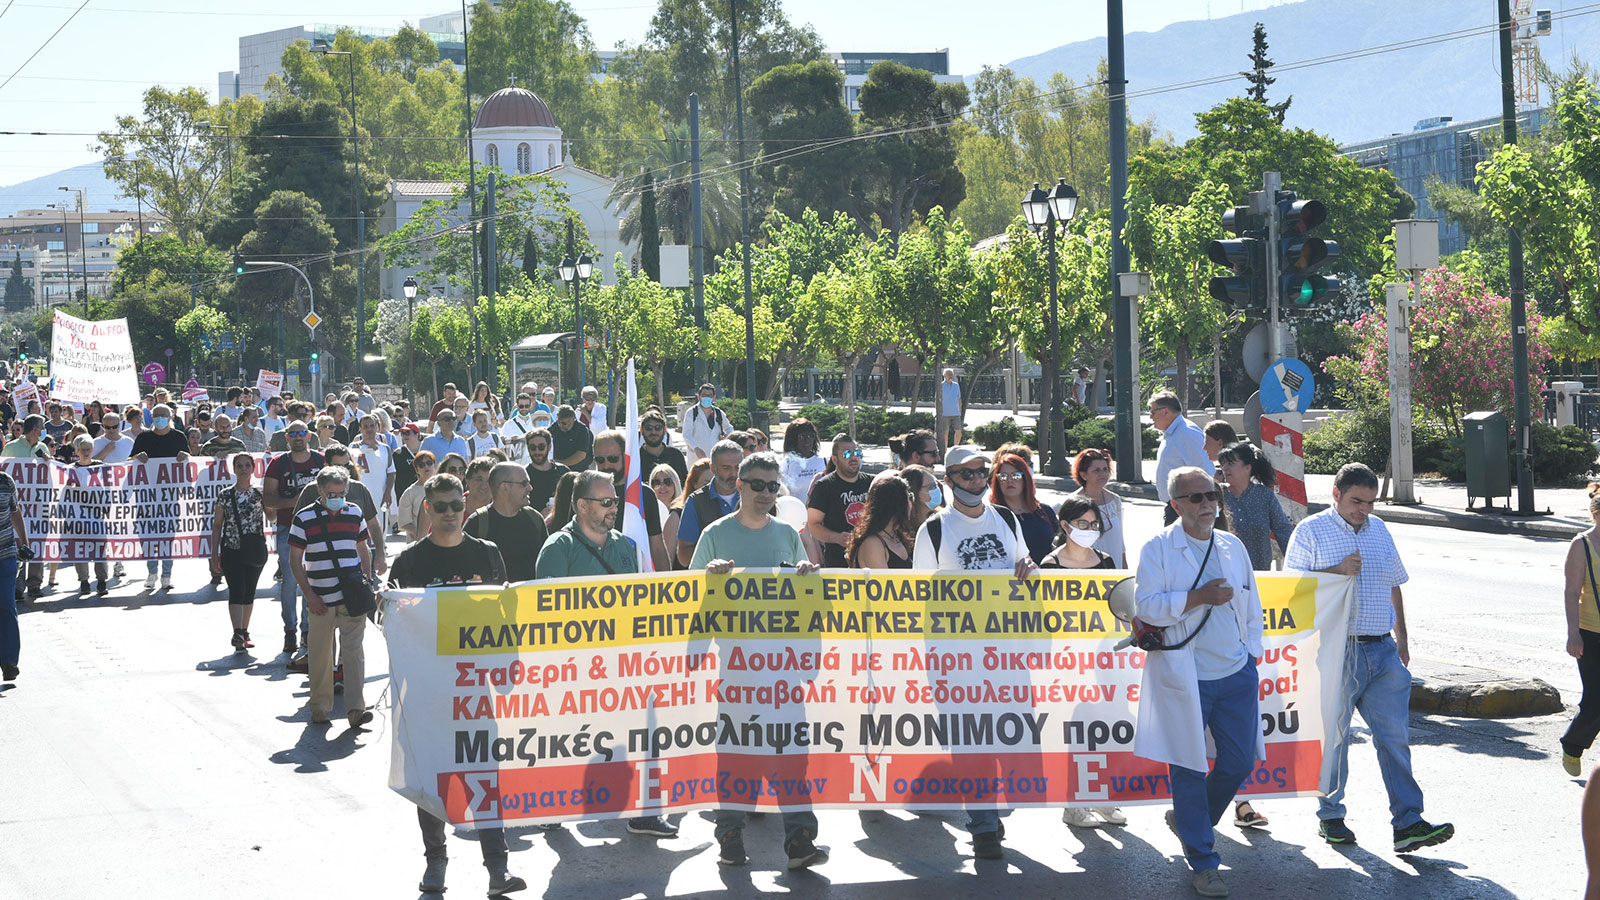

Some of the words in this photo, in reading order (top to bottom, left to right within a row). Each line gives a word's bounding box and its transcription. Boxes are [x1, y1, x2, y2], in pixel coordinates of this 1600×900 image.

[56, 465, 81, 487] ΤΑ
[87, 464, 149, 487] ΧΕΡΙΑ
[157, 461, 198, 485] ΑΠΟ
[206, 461, 231, 481] ΤΑ
[17, 488, 31, 502] ΧΙ
[35, 488, 60, 503] ΣΤΙΣ
[64, 489, 129, 505] ΑΠΟΛΥΣΕΙΣ
[133, 488, 157, 503] ΤΩΝ
[19, 504, 37, 518] ΧΙ
[42, 505, 75, 518] ΞΑΝΑ
[80, 505, 110, 519] ΣΤΟΝ
[116, 503, 181, 519] ΕΡΓΑΣΙΑΚΟ
[30, 520, 128, 535] ΜΟΝΙΜΟΠΟΙΗΣΗ
[75, 538, 193, 559] ΕΡΓΑΖΟΜΕΝΩΝ
[537, 580, 698, 612] ΕΠΙΚΟΥΡΙΚΟΙ
[724, 577, 797, 601] ΟΑΕΔ
[823, 578, 982, 602] ΕΡΓΟΛΑΒΙΚΟΙ
[459, 618, 616, 650] ΚΑΛΥΠΤΟΥΝ
[632, 610, 800, 639] ΕΠΙΤΑΚΤΙΚΕΣ
[807, 610, 924, 634] ΑΝΑΓΚΕΣ
[930, 611, 977, 634] ΣΤΑ
[985, 611, 1106, 633] ΔΗΜΟΣΙΑ
[455, 656, 578, 688] Σταθερή
[588, 654, 608, 681] &
[618, 650, 716, 678] Μόνιμη
[727, 646, 839, 671] Δουλειά
[851, 651, 882, 676] με
[892, 647, 973, 676] πλήρη
[983, 646, 1145, 675] δικαιώματα
[452, 693, 550, 721] ΚΑΜΙΑ
[559, 681, 697, 716] ΑΠΟΛΥΣΗ!
[705, 679, 836, 710] Καταβολή
[847, 685, 896, 704] των
[904, 679, 1116, 708] δεδουλευμένων
[454, 724, 615, 767] Μαζικές
[628, 713, 845, 758] προσλήψεις
[858, 712, 1050, 747] ΜΟΝΙΜΟΥ
[463, 771, 611, 821] Σωματείο
[635, 759, 828, 809] Εργαζομένων
[849, 755, 1049, 802] Νοσοκομείου
